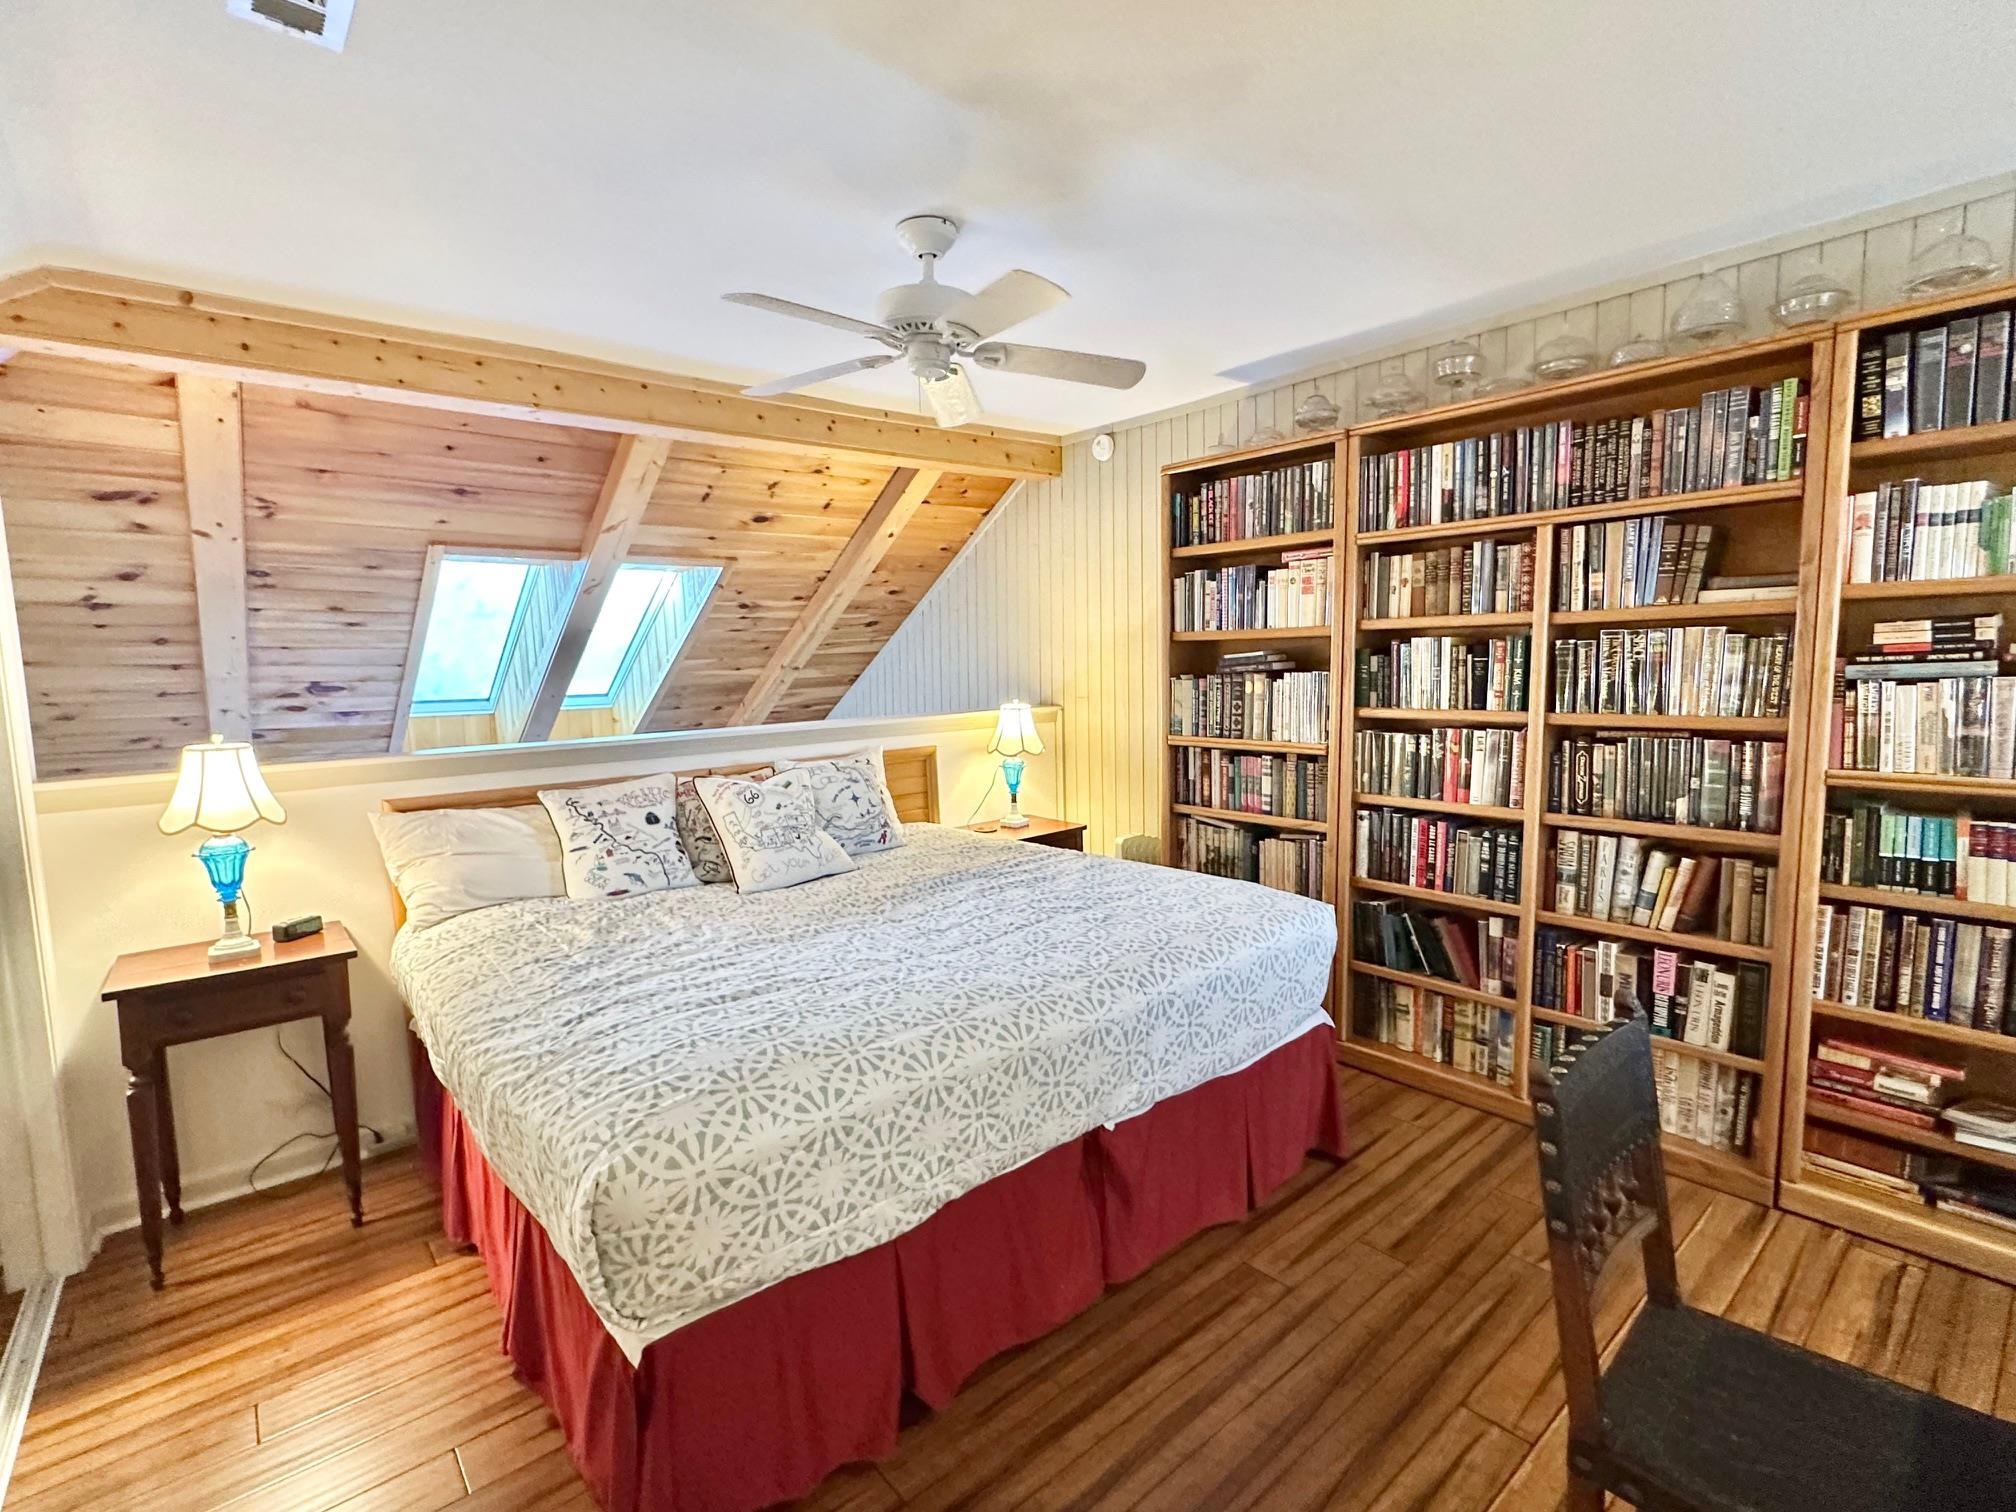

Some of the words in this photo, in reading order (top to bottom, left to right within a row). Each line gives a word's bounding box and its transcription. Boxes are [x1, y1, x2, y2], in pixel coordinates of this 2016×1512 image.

[1513, 668, 1523, 686] KIM
[744, 790, 760, 804] 66
[1598, 840, 1609, 902] PARIS
[1657, 952, 1674, 975] LEON
[1619, 973, 1632, 990] MI
[1694, 984, 1706, 1007] LEON
[1690, 1010, 1702, 1033] URIS
[1710, 1000, 1726, 1044] Armageddon
[1531, 1031, 1543, 1060] TRINI
